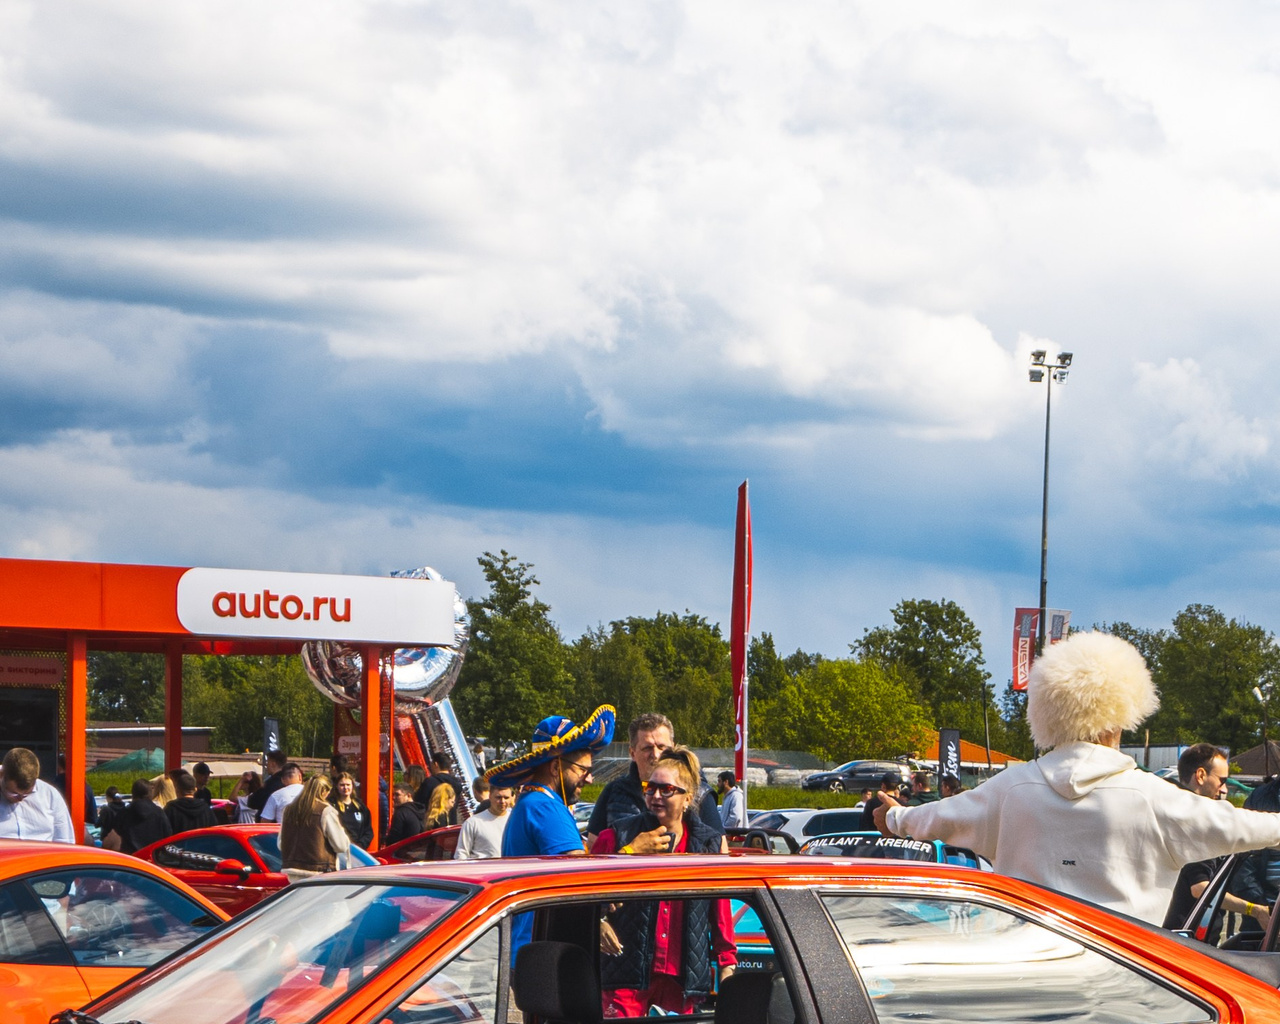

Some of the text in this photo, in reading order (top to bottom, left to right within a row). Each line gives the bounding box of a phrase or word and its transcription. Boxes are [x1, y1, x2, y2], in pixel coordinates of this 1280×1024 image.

[212, 589, 351, 622] auto.ru
[875, 837, 932, 853] KREMER
[736, 961, 763, 969] uto.ru
